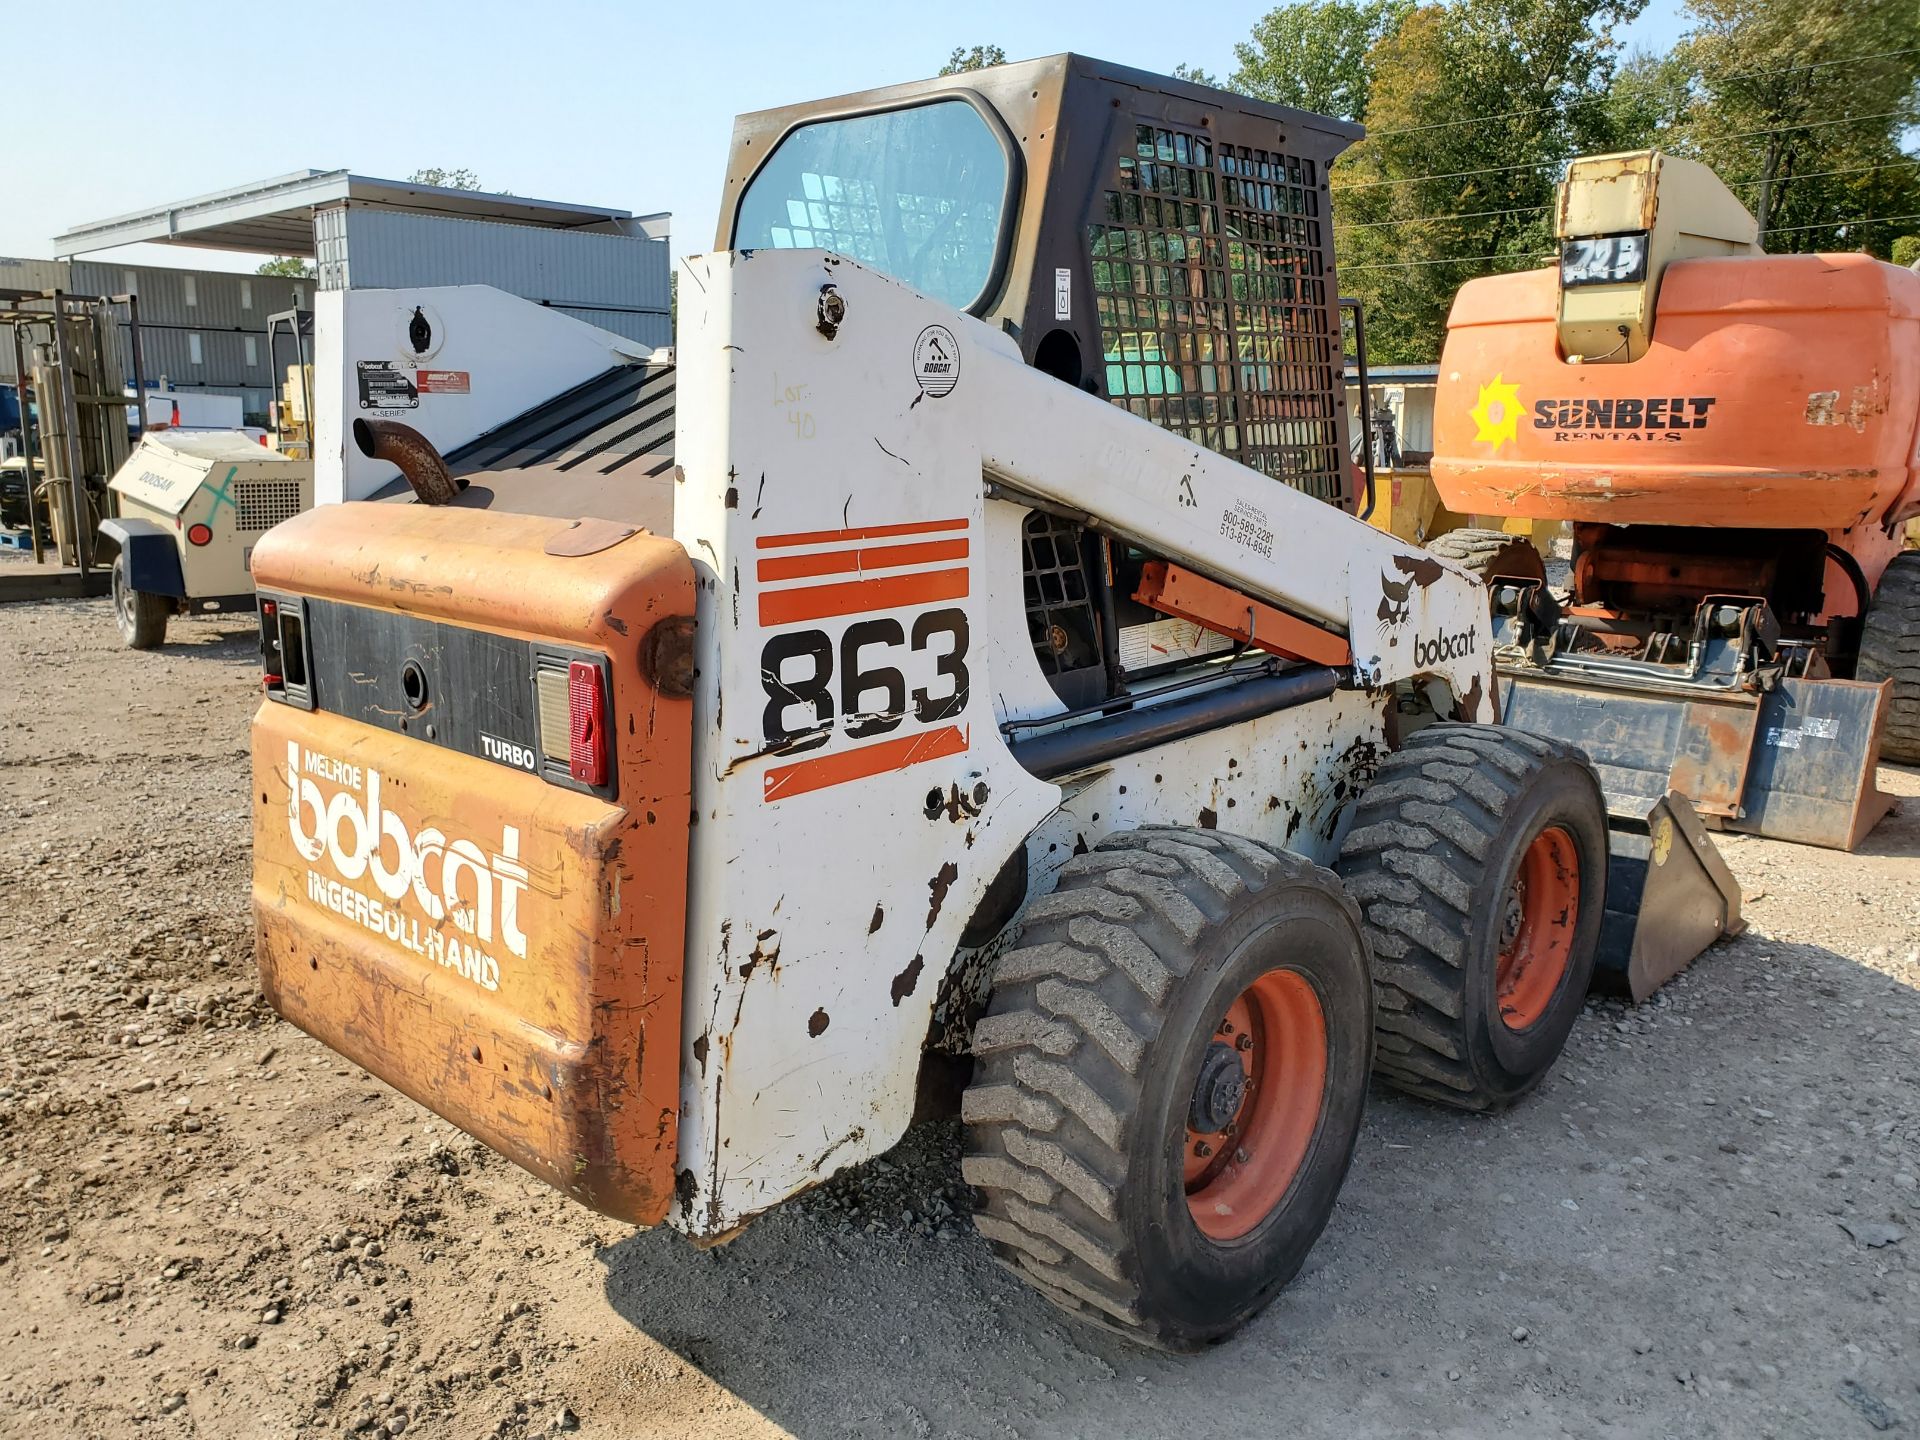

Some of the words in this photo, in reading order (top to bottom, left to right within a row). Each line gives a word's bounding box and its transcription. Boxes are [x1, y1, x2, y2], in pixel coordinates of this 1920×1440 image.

[923, 362, 951, 374] BOBCAT
[787, 411, 817, 441] 40
[1533, 397, 1717, 430] SUNBELT
[1554, 431, 1683, 443] RENTALS
[138, 471, 175, 492] DOOSAN
[227, 476, 306, 484] oosanPortablePower.com
[1220, 523, 1273, 559] 513-874-8945
[1223, 509, 1274, 546] 800-589-2281
[1414, 624, 1476, 669] bobcat
[760, 607, 970, 757] 863
[305, 749, 362, 790] MELROE
[481, 735, 535, 770] TURBO
[288, 740, 529, 960] bobcat
